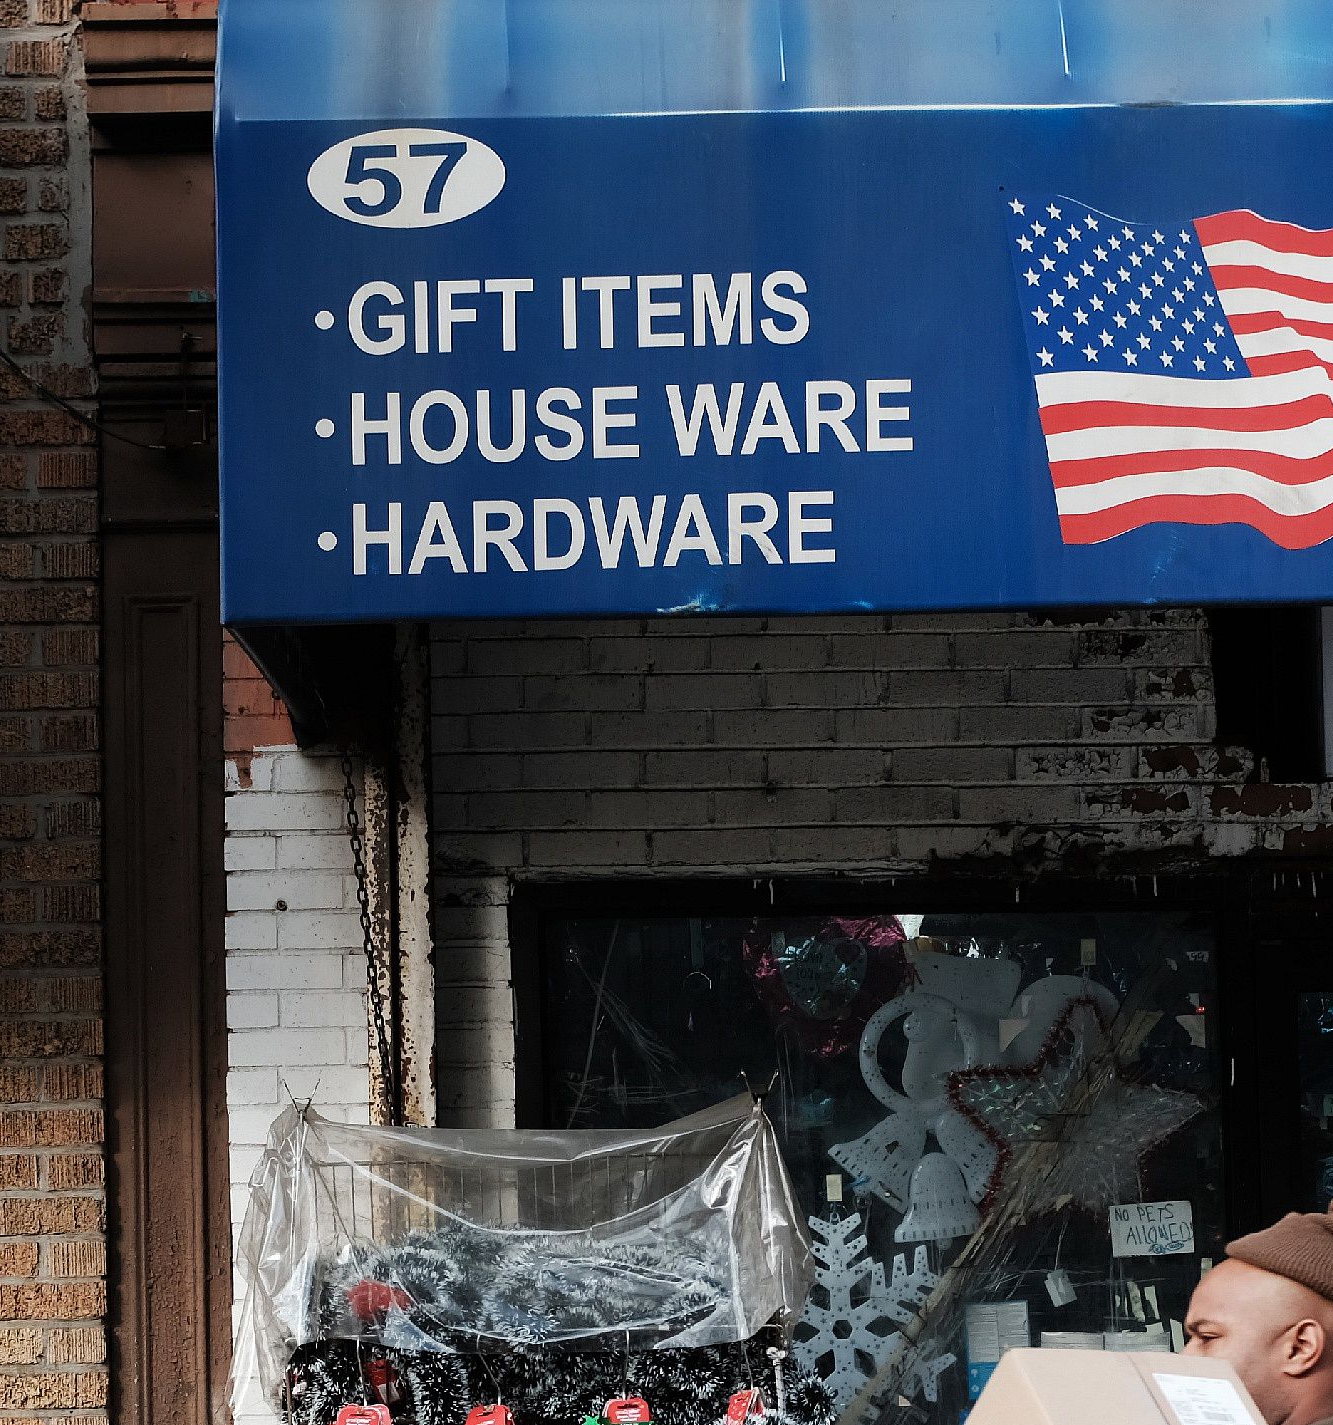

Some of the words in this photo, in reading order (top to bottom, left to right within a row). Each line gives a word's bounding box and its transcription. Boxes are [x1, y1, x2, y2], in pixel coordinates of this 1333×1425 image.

[341, 142, 468, 217] 57
[348, 278, 534, 356] GIFT
[563, 270, 811, 351] ITEMS
[350, 385, 640, 467] HOUSE
[666, 378, 914, 457] WARE
[351, 490, 836, 577] HARDWARE
[1114, 1207, 1129, 1221] NO
[1136, 1203, 1174, 1223] PETS
